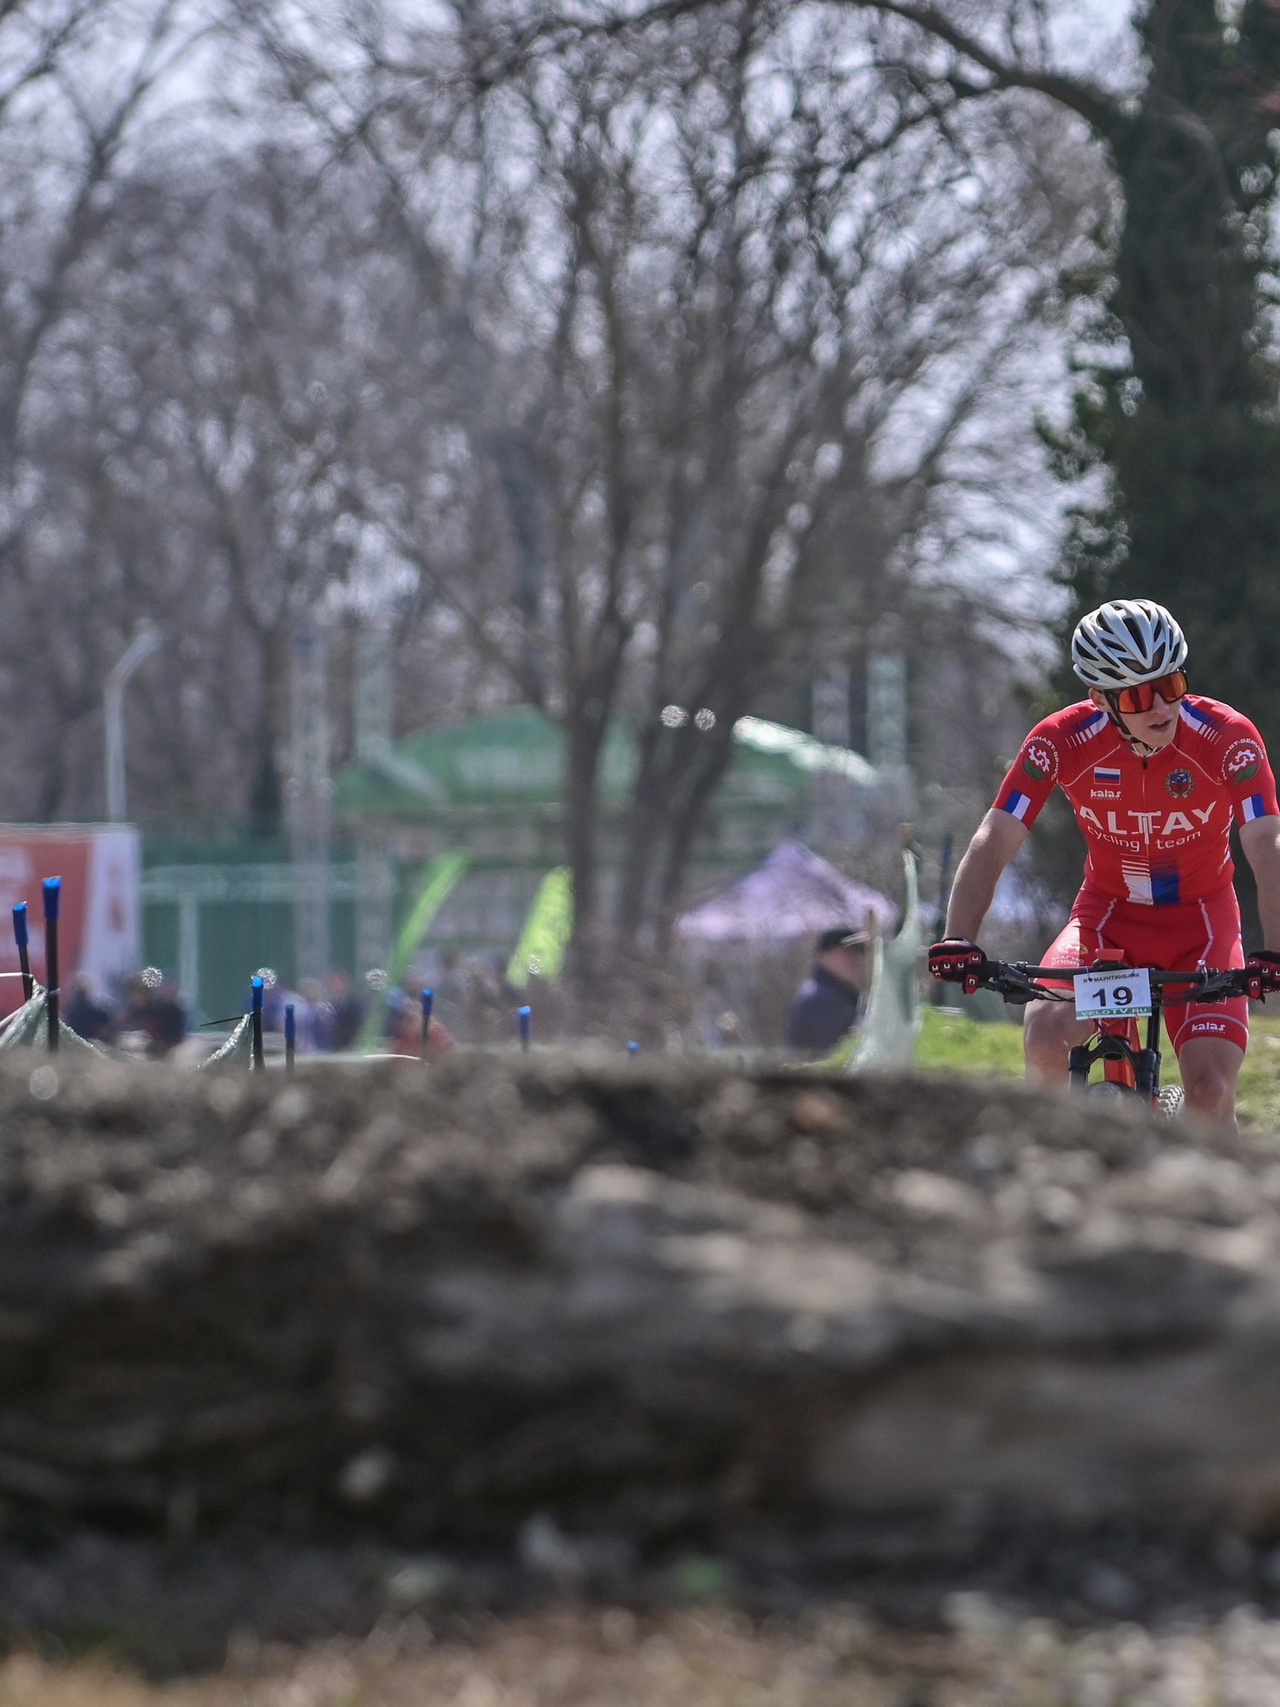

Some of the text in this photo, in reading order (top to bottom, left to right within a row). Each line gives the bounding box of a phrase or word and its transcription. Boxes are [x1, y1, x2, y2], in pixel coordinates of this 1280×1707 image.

[1090, 789, 1122, 798] kalas
[1080, 801, 1217, 835] ALTAY
[1088, 825, 1201, 852] cycling team
[1092, 986, 1134, 1007] 19
[1192, 1022, 1226, 1032] kalas
